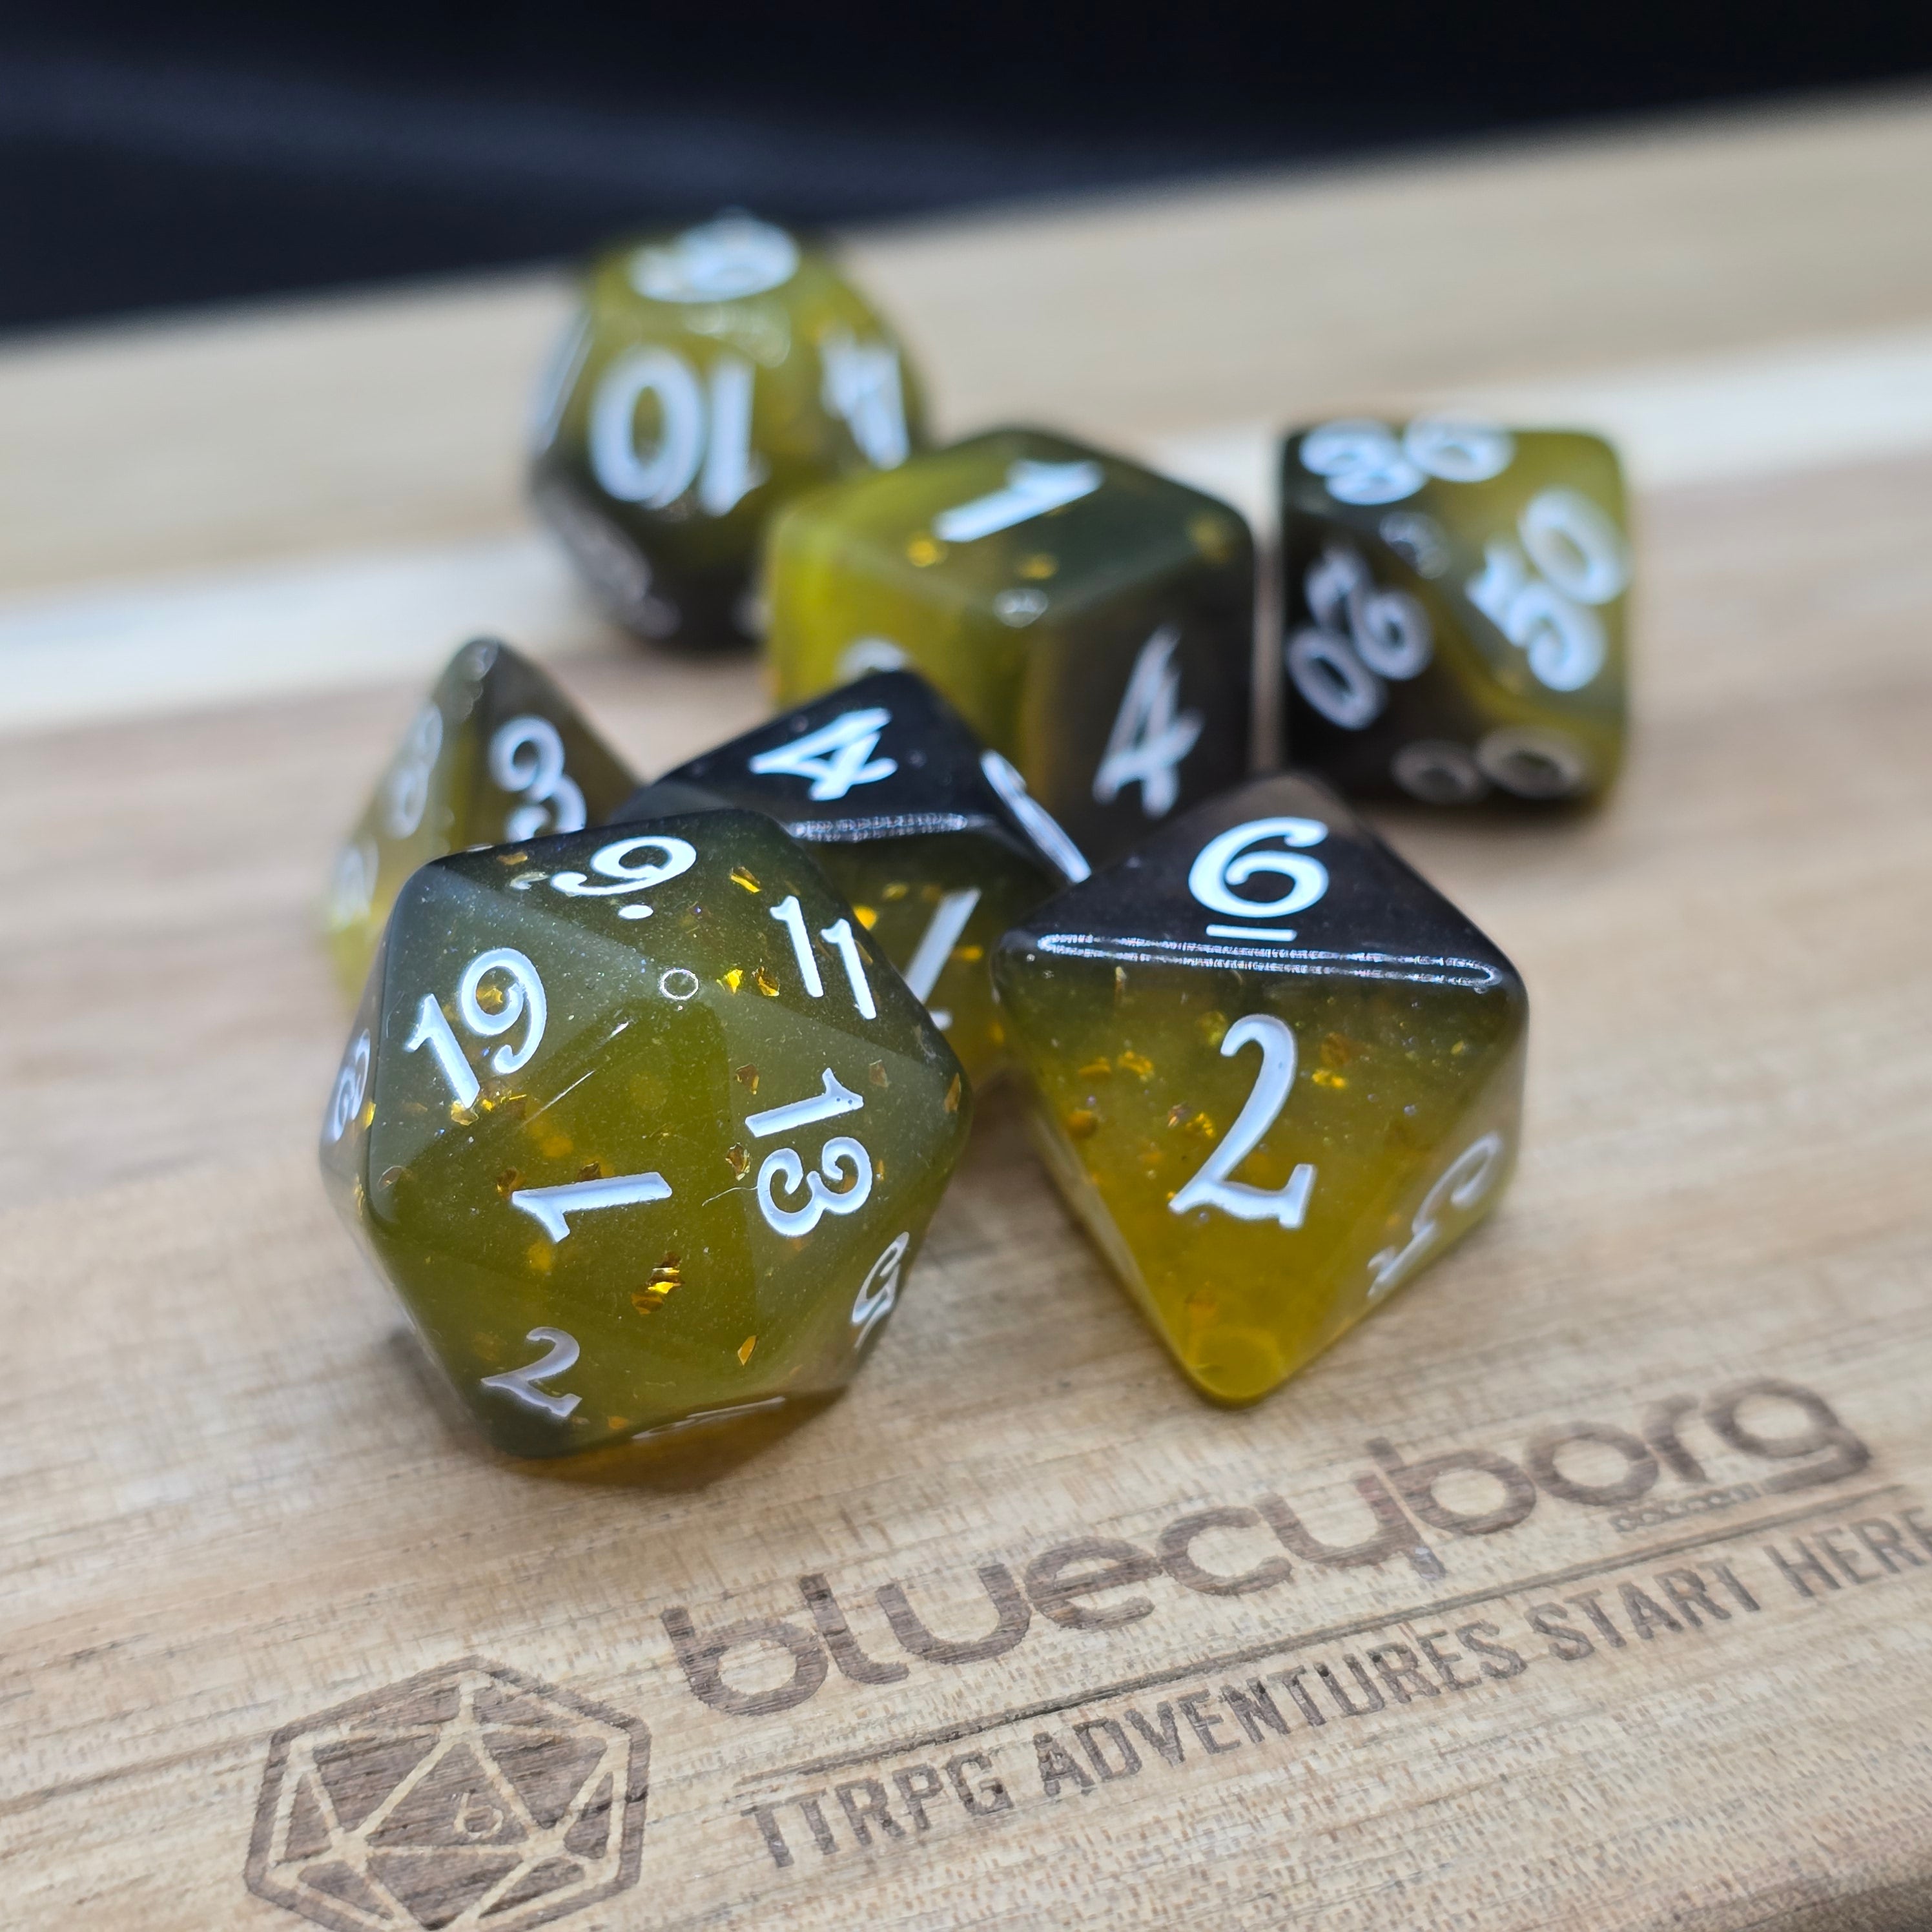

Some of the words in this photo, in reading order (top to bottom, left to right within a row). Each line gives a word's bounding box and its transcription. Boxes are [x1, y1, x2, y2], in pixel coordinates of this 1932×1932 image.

[934, 459, 1104, 542] 1
[1467, 488, 1629, 691] 50
[750, 708, 898, 801] 4
[1093, 628, 1206, 819] 4
[1189, 817, 1329, 918] 6
[406, 947, 547, 1109] 19
[770, 895, 876, 1020] 11
[745, 1067, 872, 1236] 13
[1169, 1014, 1317, 1229] 2
[511, 1172, 673, 1244] 1
[481, 1326, 581, 1418] 2
[661, 1375, 1872, 1716] bluecyborg
[741, 1749, 1014, 1867] TTRPG
[1034, 1620, 1526, 1797] ADVENTURES
[1526, 1557, 1762, 1661] START
